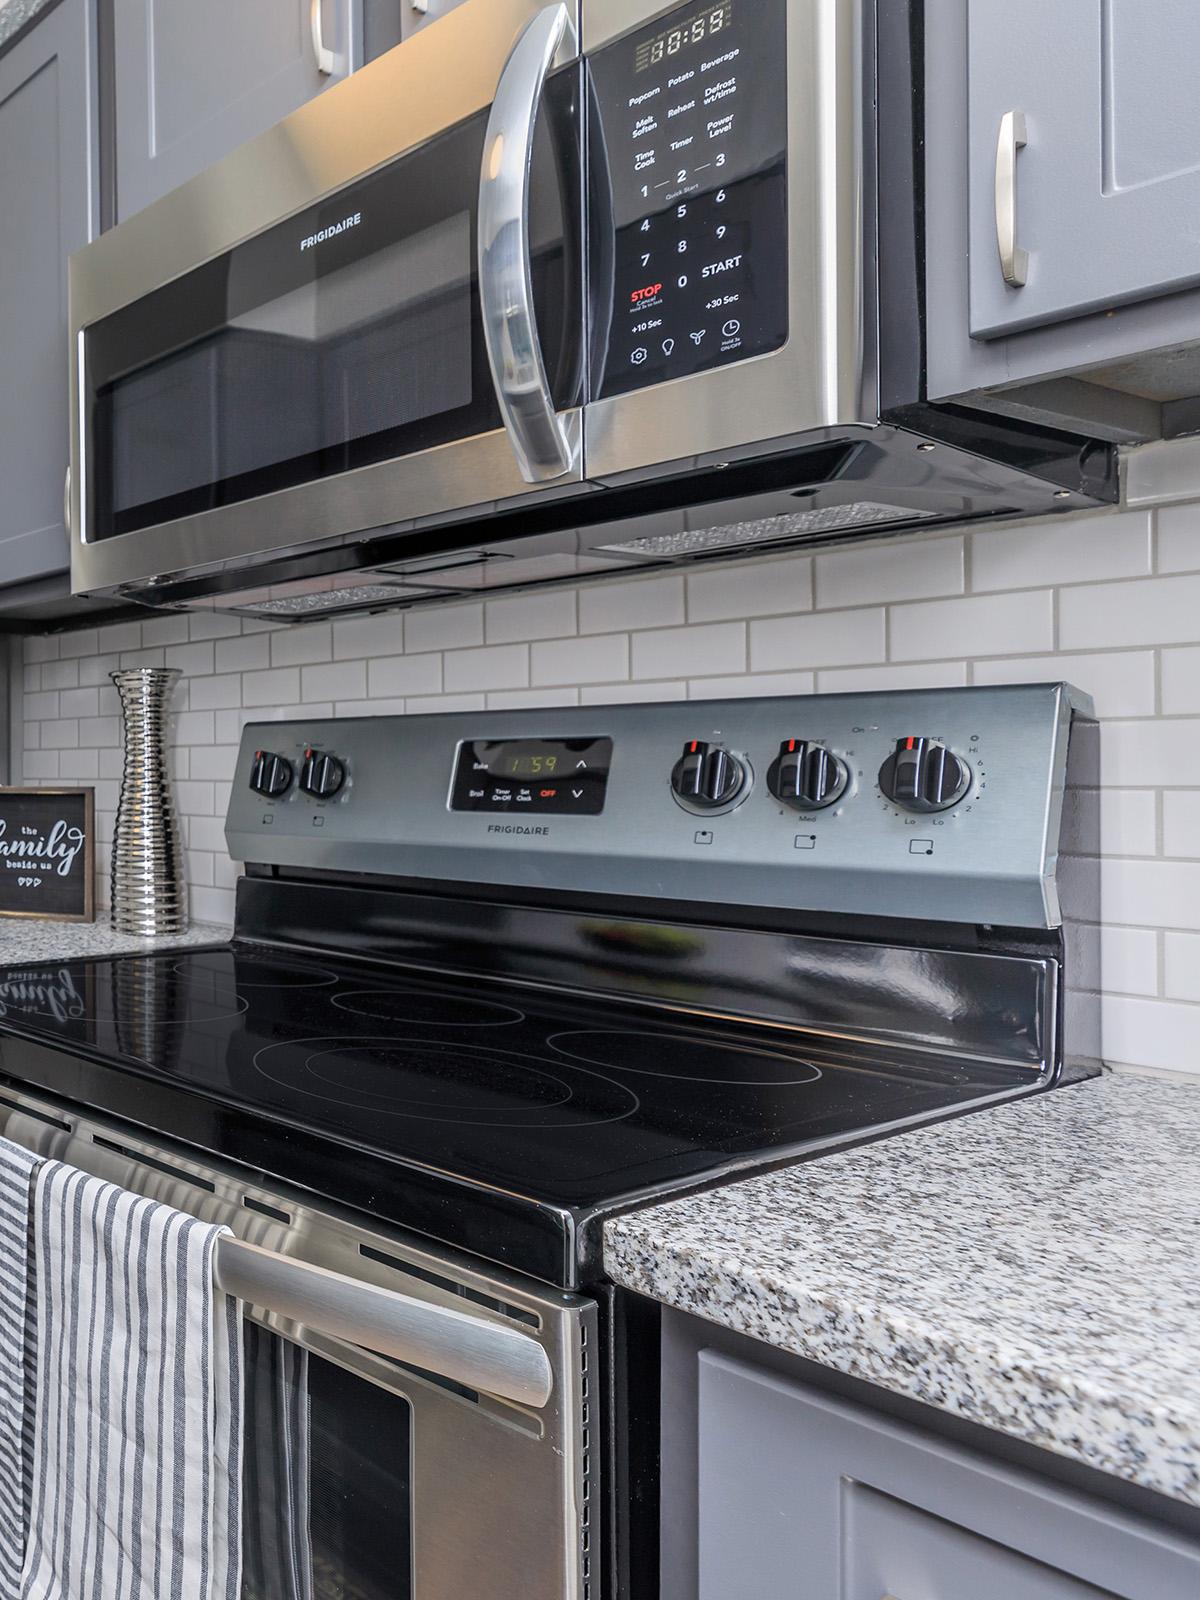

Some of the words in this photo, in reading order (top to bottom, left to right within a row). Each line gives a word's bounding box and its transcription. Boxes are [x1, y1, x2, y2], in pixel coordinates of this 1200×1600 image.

[650, 8, 724, 64] 10:59
[700, 48, 740, 72] Beverage
[667, 70, 695, 88] Potato
[704, 77, 736, 97] Defrost
[628, 86, 661, 107] Popcorn
[667, 100, 696, 119] Reheat
[631, 122, 658, 139] Soften
[707, 114, 735, 131] Power
[709, 121, 732, 139] Level
[669, 136, 694, 151] Timer
[633, 156, 656, 171] Cook
[634, 149, 655, 162] Time
[640, 185, 648, 198] 1
[677, 169, 687, 183] 2
[715, 153, 726, 167] 3
[640, 219, 650, 232] 4
[677, 204, 687, 218] 5
[715, 189, 726, 203] 6
[300, 212, 361, 251] FRIGIDAIRE
[641, 253, 650, 267] 7
[677, 240, 687, 253] 8
[715, 225, 726, 239] 9
[701, 255, 742, 278] START
[677, 275, 688, 288] 0
[630, 283, 663, 303] STOP
[705, 299, 723, 310] +30
[723, 294, 740, 305] Sec
[631, 322, 647, 334] +10
[647, 319, 663, 330] Sec
[540, 789, 557, 798] OFF
[21, 826, 38, 836] the
[487, 824, 550, 836] FRIGIDAIRE
[6, 860, 37, 870] beside
[40, 862, 52, 870] us
